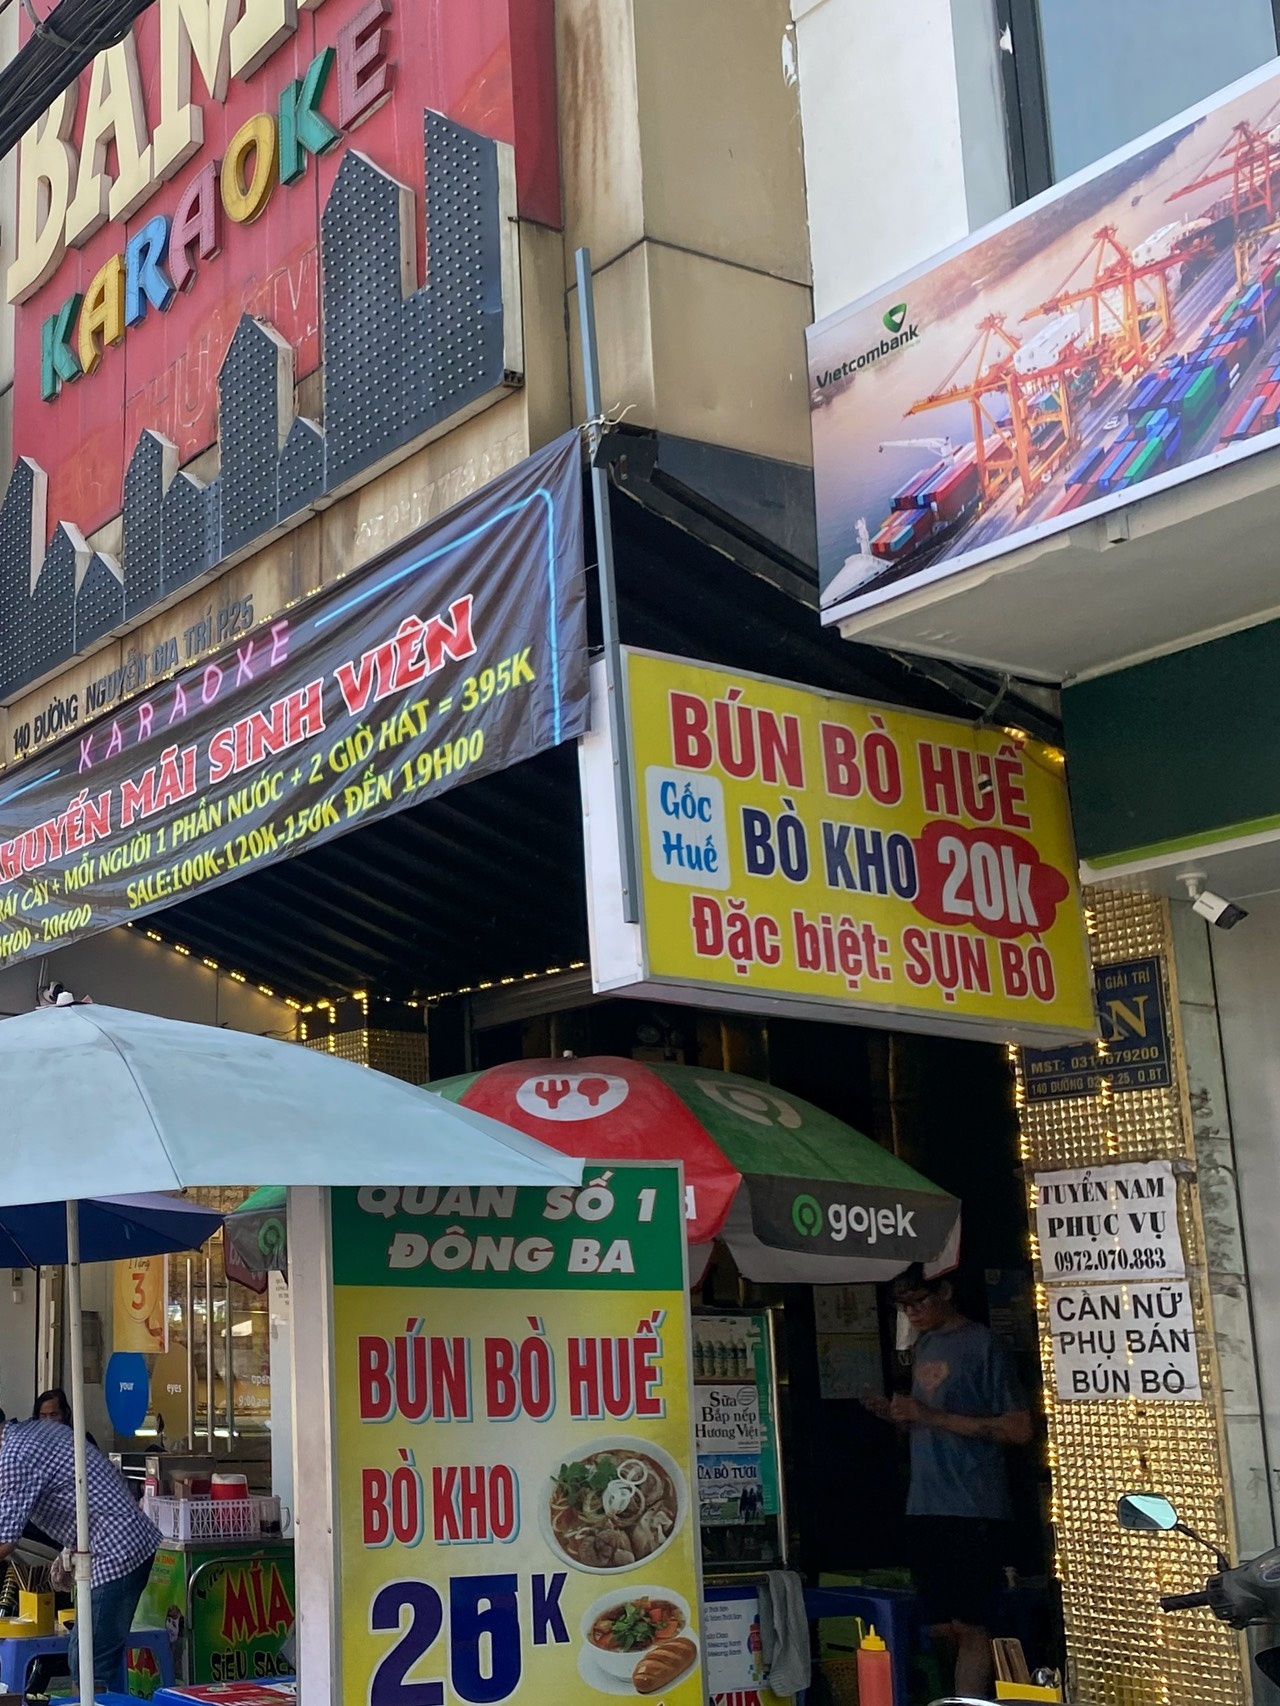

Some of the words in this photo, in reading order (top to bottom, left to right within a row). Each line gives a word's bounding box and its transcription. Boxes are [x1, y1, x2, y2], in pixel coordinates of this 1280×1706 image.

[40, 0, 396, 401] KARAOKE
[816, 323, 920, 390] Vietcombank
[33, 694, 78, 743] ĐƯỜNG
[85, 648, 147, 716] NGUYỄN
[152, 643, 179, 675] GIA
[183, 605, 213, 662] TRÍ
[78, 620, 289, 774] KARAOKE
[119, 743, 198, 830] MÃI
[208, 677, 326, 786] SINH
[333, 593, 478, 717] VIÊN
[98, 827, 153, 876] NGƯỜI
[157, 828, 166, 856] 1
[172, 800, 221, 848] PHẦN
[227, 768, 284, 822] NƯỚC
[308, 752, 323, 784] 2
[328, 722, 374, 774] GIỜ
[378, 697, 430, 751] HÁT
[438, 696, 453, 716] =
[461, 646, 536, 713] 395K
[345, 765, 393, 818] ĐẾN
[402, 729, 484, 794] 19H00
[668, 686, 804, 789] BÚN
[822, 715, 903, 805] BÒ
[919, 738, 1032, 829] HUẾ
[660, 781, 713, 823] Gốc
[662, 830, 719, 874] Huế
[741, 798, 810, 883] BÒ
[822, 821, 920, 900] KHO
[43, 902, 92, 943] 20H00
[691, 895, 782, 976] Đặc
[793, 910, 892, 990] biệt:
[903, 926, 992, 1003] SỤN
[1000, 929, 1057, 1004] BÒ
[1131, 967, 1150, 984] TRÍ
[1031, 1059, 1065, 1075] MST:
[1032, 1084, 1048, 1096] 140
[543, 1169, 616, 1223] SỐ
[637, 1188, 658, 1222] 1
[1039, 1170, 1108, 1205] TUYỂN
[1115, 1176, 1165, 1200] NAM
[827, 1201, 918, 1245] gojek
[1048, 1212, 1119, 1242] PHỤC
[1128, 1211, 1167, 1240] VỤ
[388, 1224, 555, 1273] ĐÔNG
[567, 1237, 636, 1274] BA
[1054, 1247, 1167, 1272] 0972.070.883
[131, 1273, 146, 1310] 3
[1056, 1290, 1121, 1321] CẦN
[1132, 1286, 1184, 1320] NỮ
[1060, 1330, 1115, 1360] PHỤ
[1126, 1322, 1191, 1353] BÁN
[120, 1381, 134, 1392] your
[166, 1383, 182, 1393] eyes
[358, 1316, 471, 1424] BÚN
[484, 1315, 557, 1421] BÒ
[567, 1310, 667, 1420] HUẾ
[1072, 1363, 1131, 1394] BÚN
[1141, 1362, 1185, 1395] BÒ
[701, 1406, 730, 1425] Bắp
[733, 1407, 757, 1425] nếp
[709, 1391, 737, 1408] Sữa
[695, 1423, 736, 1440] Hương
[736, 1423, 759, 1439] Việt
[714, 1464, 729, 1479] BÒ
[731, 1465, 757, 1479] TƯƠI
[361, 1447, 424, 1549] BÒ
[432, 1463, 520, 1547] KHO
[222, 1551, 295, 1646] MÍA
